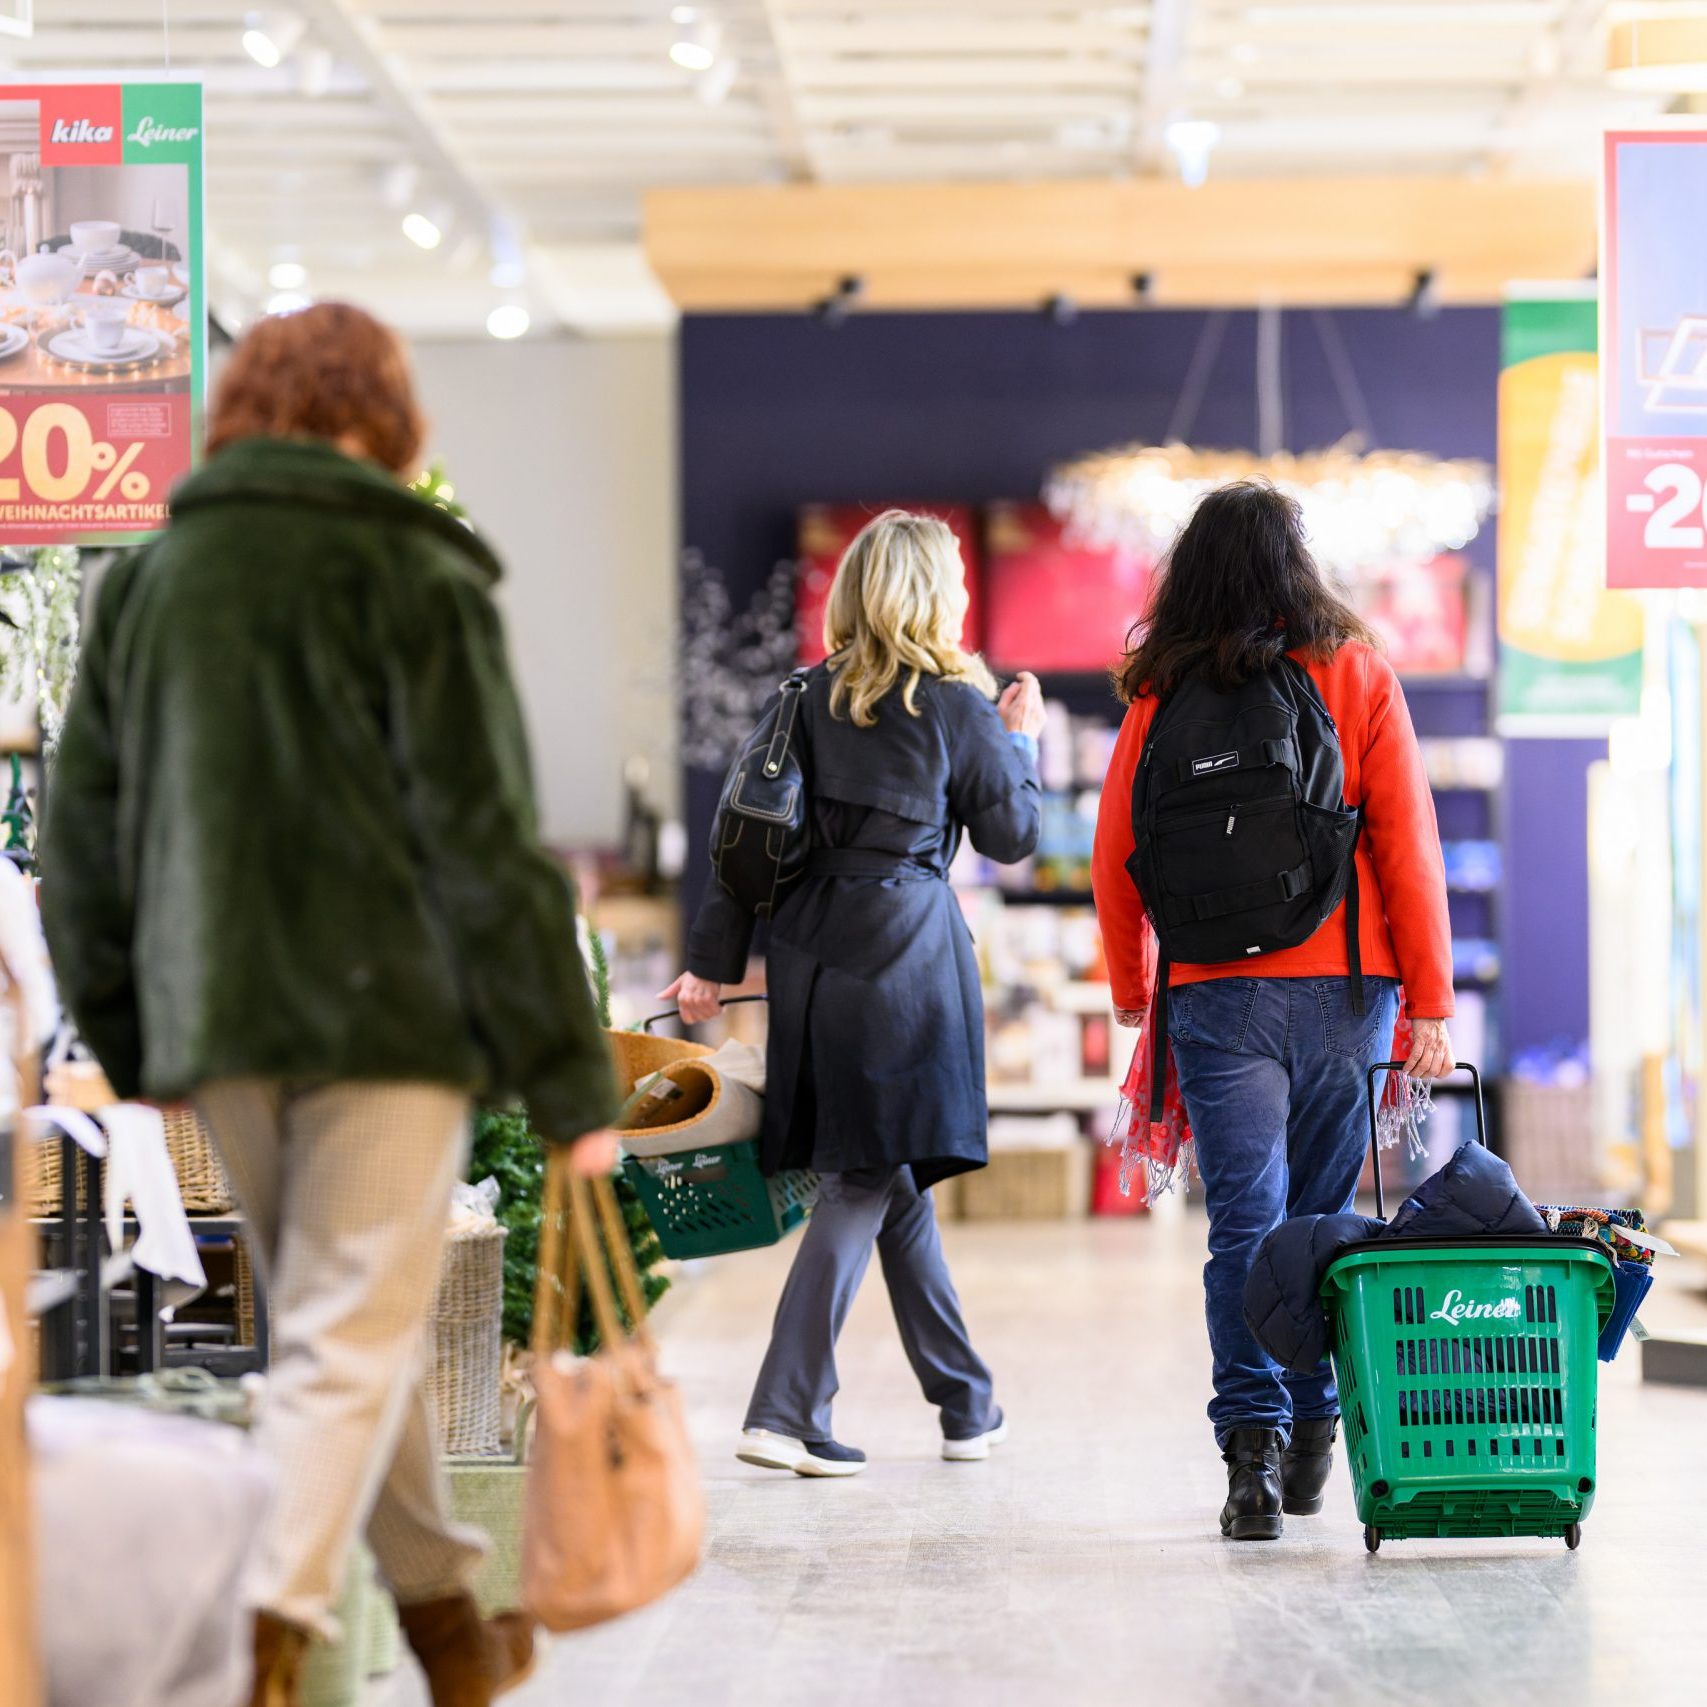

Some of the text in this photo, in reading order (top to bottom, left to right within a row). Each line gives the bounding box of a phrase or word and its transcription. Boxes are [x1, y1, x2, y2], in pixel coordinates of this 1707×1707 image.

[51, 119, 114, 144] kika
[127, 116, 199, 147] Leiner
[0, 403, 150, 502] 0%
[0, 504, 172, 521] EIHNACHTSARTIKEL
[1626, 463, 1707, 549] -2
[1195, 761, 1213, 770] PUMA
